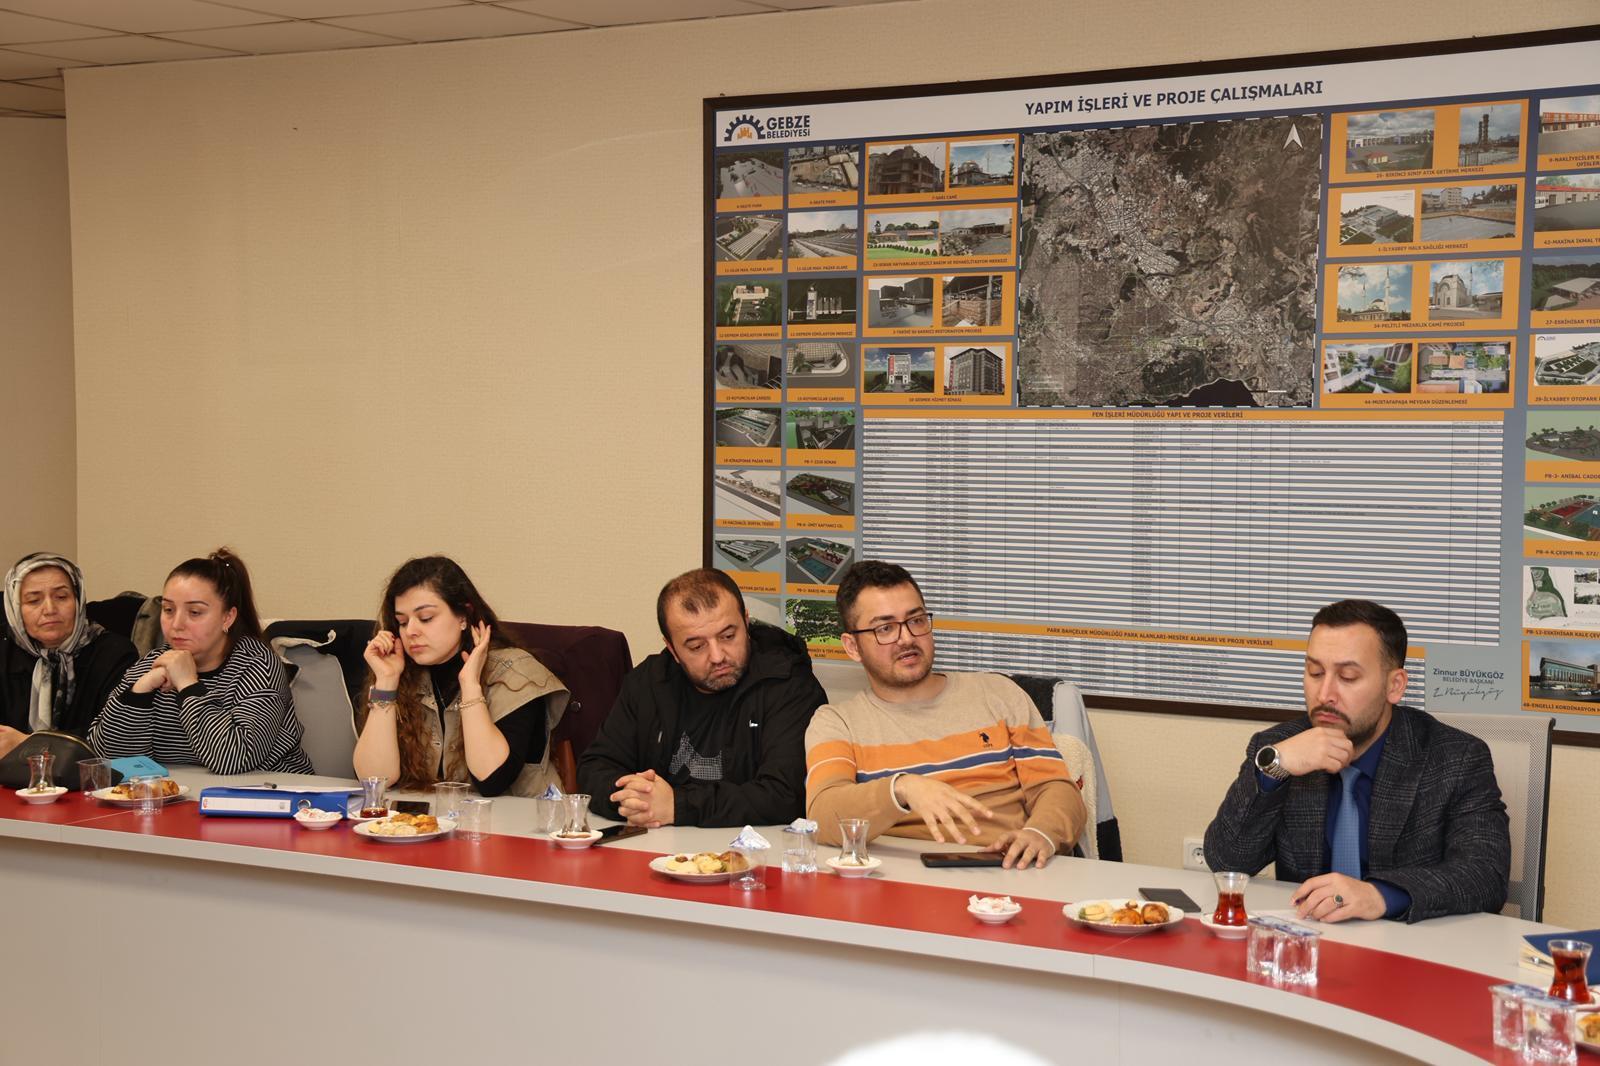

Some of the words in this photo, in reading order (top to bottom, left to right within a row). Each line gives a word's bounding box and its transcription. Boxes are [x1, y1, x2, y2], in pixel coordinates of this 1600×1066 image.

[1025, 99, 1073, 116] YAPIM
[1077, 92, 1129, 112] İŞLERİ
[1132, 94, 1152, 108] VE
[1156, 90, 1206, 106] PROJE
[1210, 80, 1323, 104] ÇALIŞMALARI
[766, 115, 810, 130] GEBZE
[766, 128, 810, 139] BELEDİYESİ
[1433, 668, 1458, 676] Zinnur
[1460, 669, 1504, 680] BÜYÜKGÖZ
